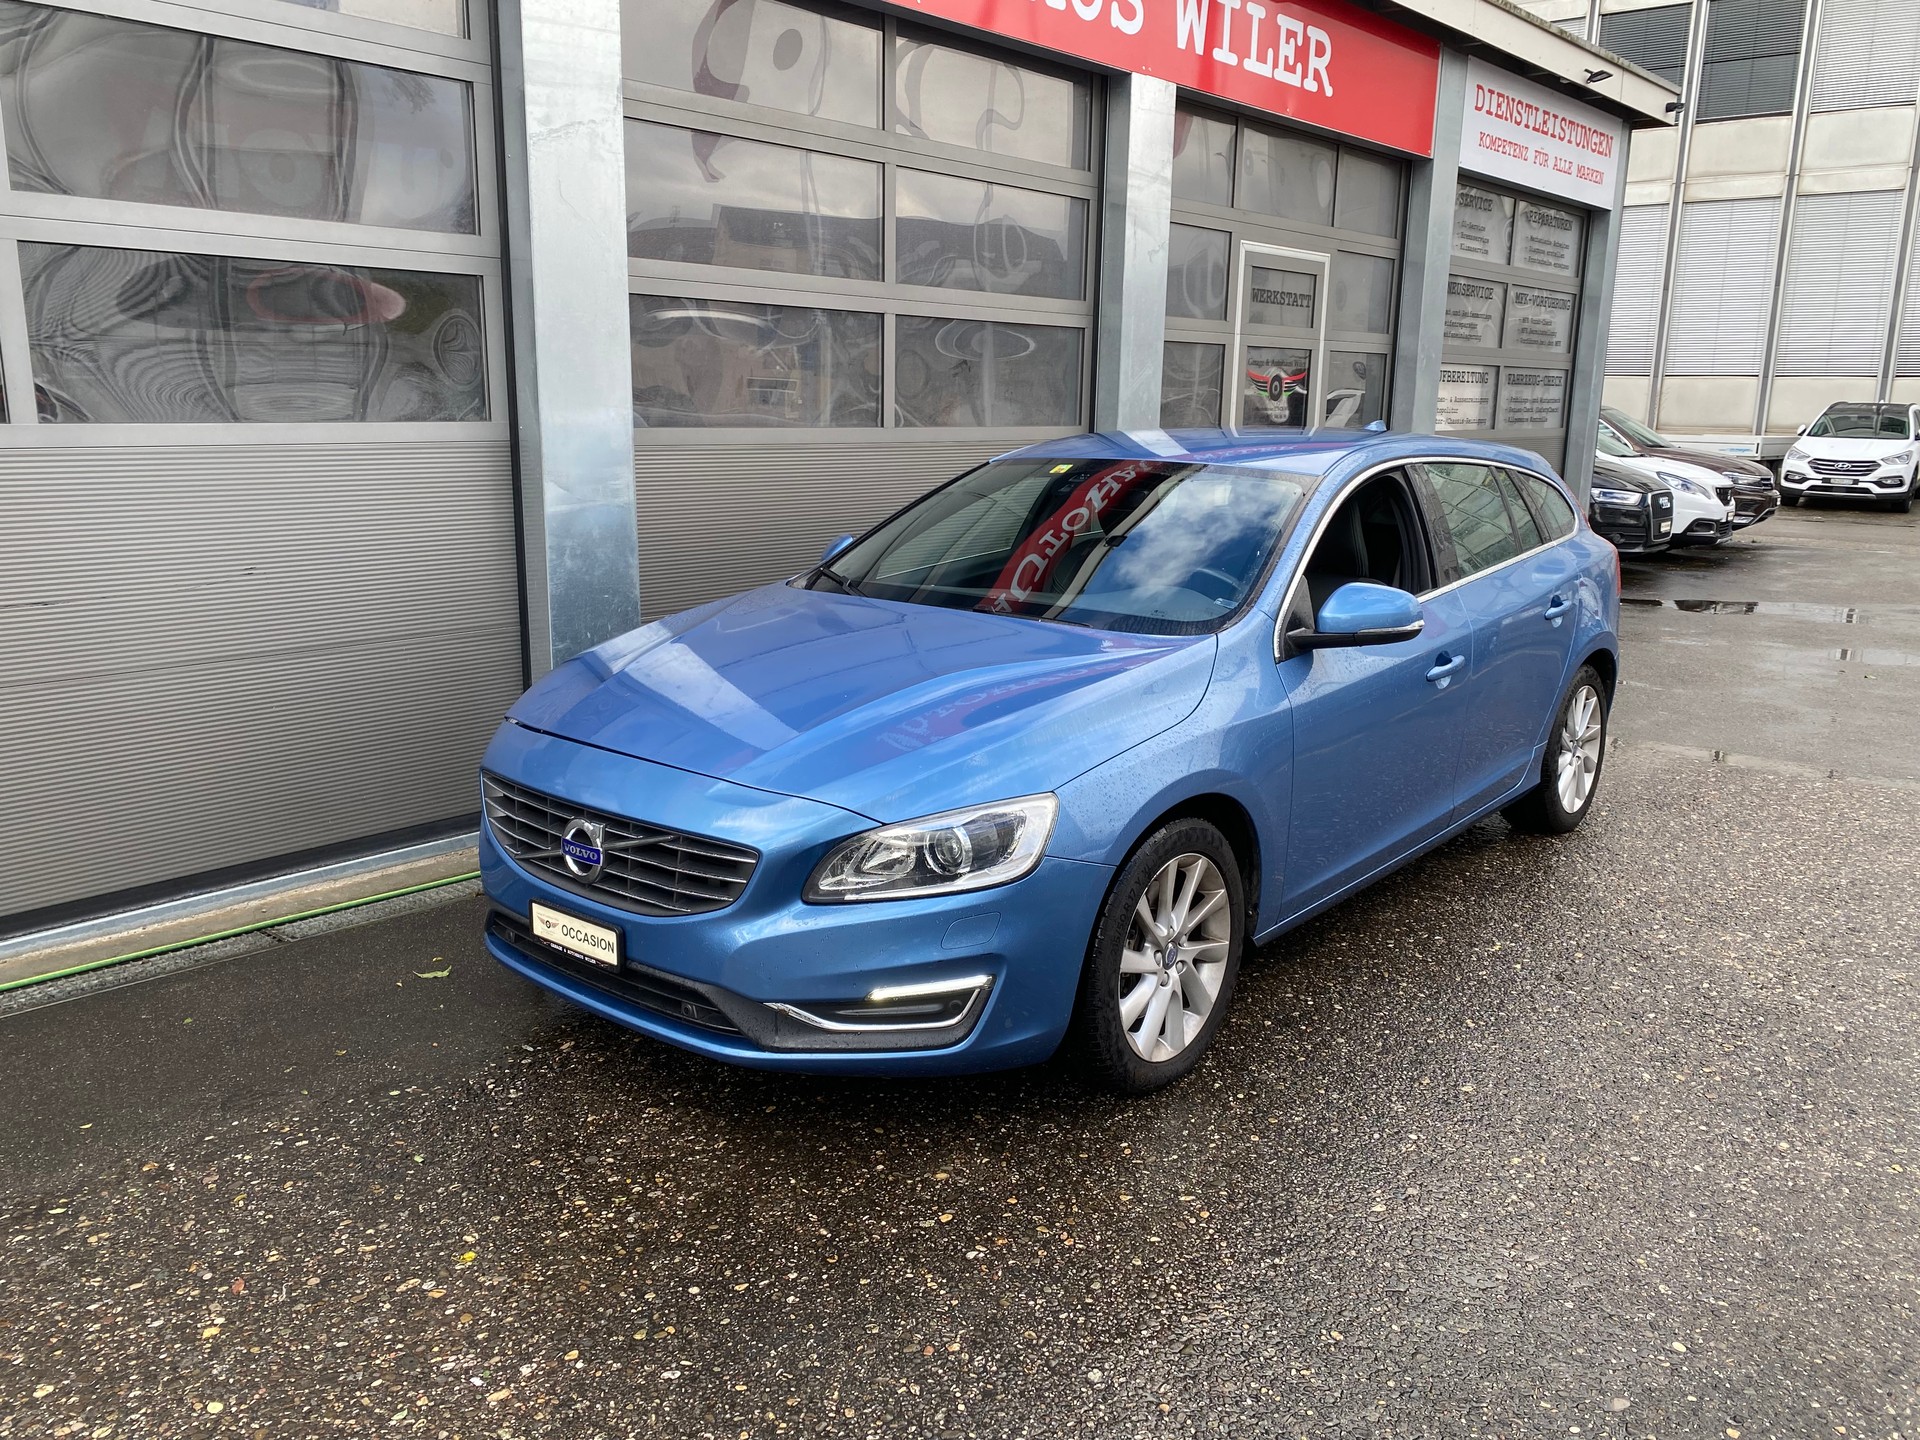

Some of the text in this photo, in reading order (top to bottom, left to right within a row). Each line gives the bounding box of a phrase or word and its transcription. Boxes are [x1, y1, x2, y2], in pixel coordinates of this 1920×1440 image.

[1175, 0, 1334, 97] WILER
[1474, 84, 1614, 158] DIENSTLEISTUNGEN
[1478, 131, 1605, 185] KOMPETENZ FÜR ALLE MARKEN
[1456, 191, 1493, 213] SERVICE
[1251, 287, 1312, 308] WERKSTATT
[1447, 281, 1494, 300] NEUSERVICE
[1438, 369, 1489, 384] UFBEREITUNG
[564, 843, 598, 860] VOLVO
[561, 924, 615, 954] OCCASION
